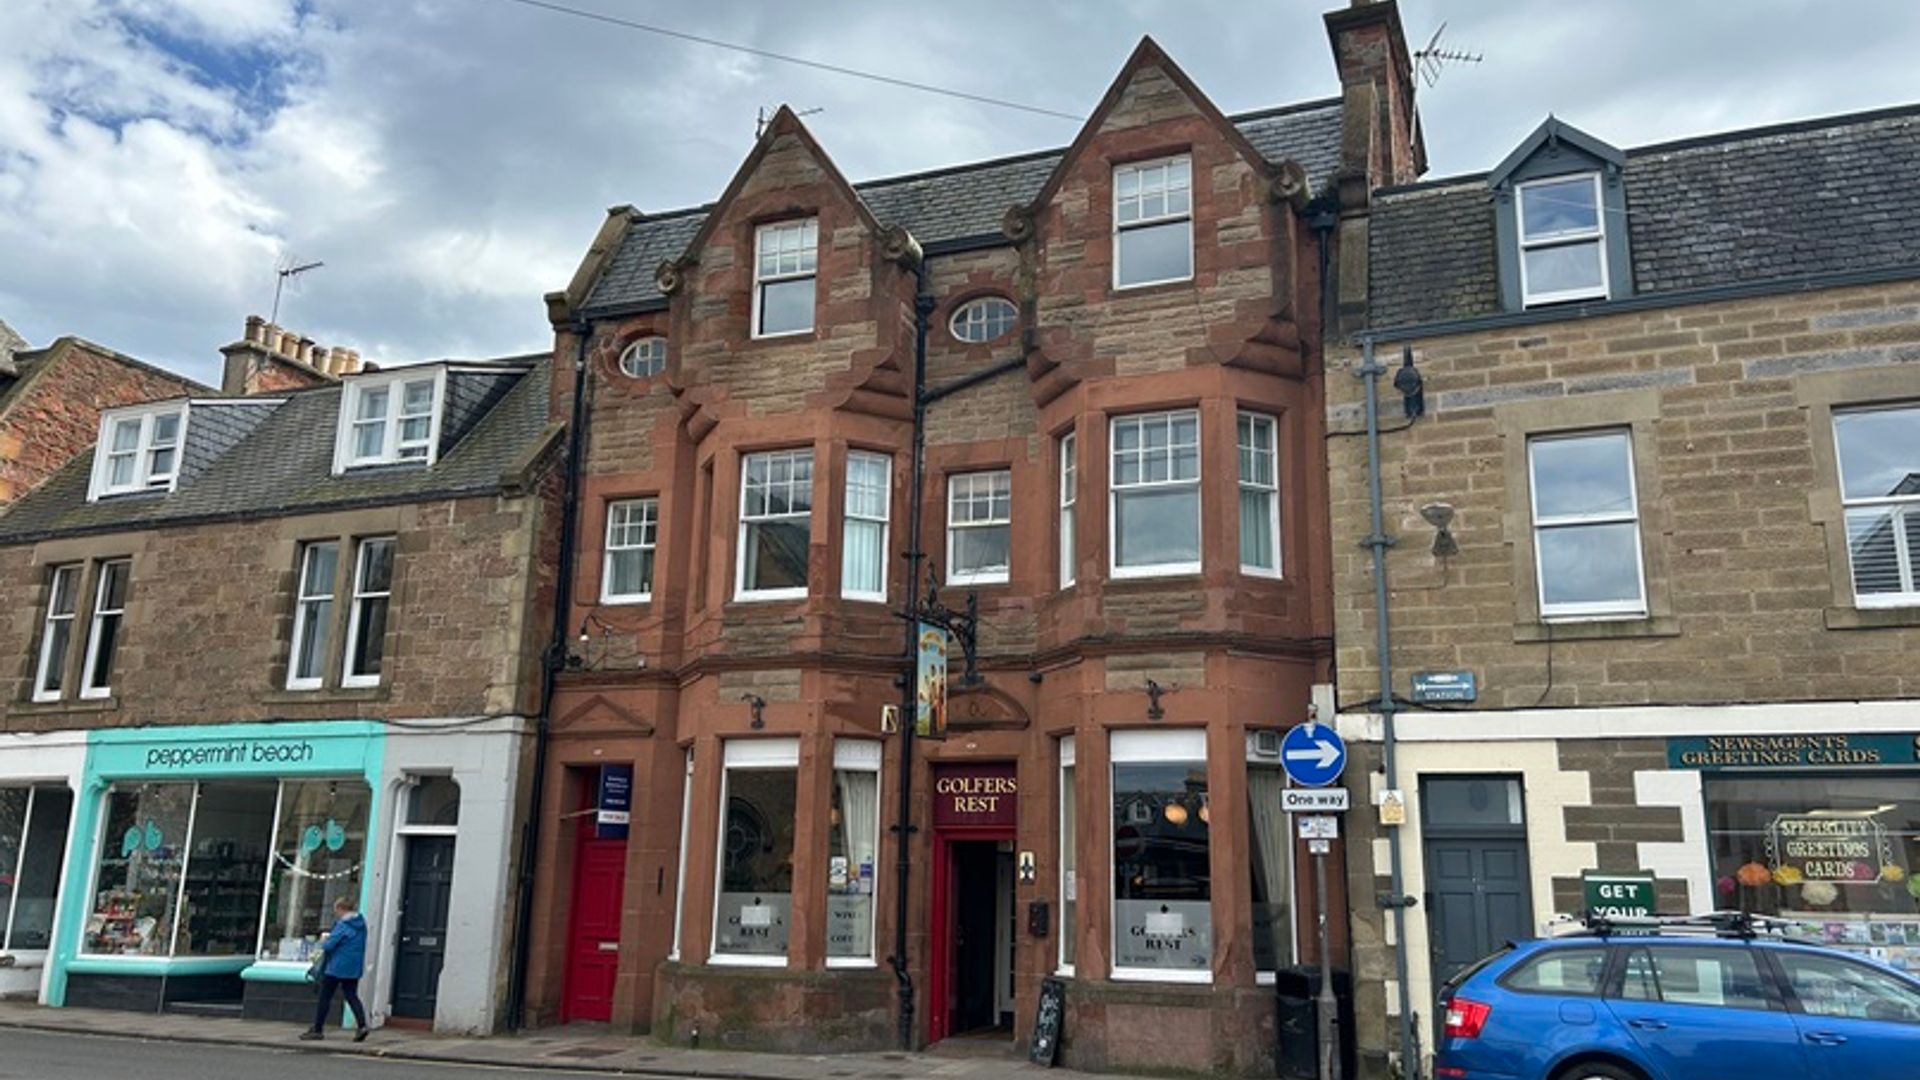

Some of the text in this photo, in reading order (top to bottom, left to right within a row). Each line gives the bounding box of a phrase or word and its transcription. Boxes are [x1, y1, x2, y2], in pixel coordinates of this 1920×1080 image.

[1709, 735, 1848, 751] NEWSAGENTS
[146, 737, 314, 768] peppermint beach
[1682, 749, 1881, 765] GREETINGS CARDS
[936, 777, 1017, 793] GOLFERS
[954, 796, 1000, 812] REST
[1287, 793, 1345, 807] One way
[1780, 820, 1869, 836] SPECIALITY
[1786, 841, 1870, 857] GREETINGS
[1805, 860, 1855, 878] CARDS
[1599, 884, 1639, 898] GET
[1145, 939, 1181, 950] REST
